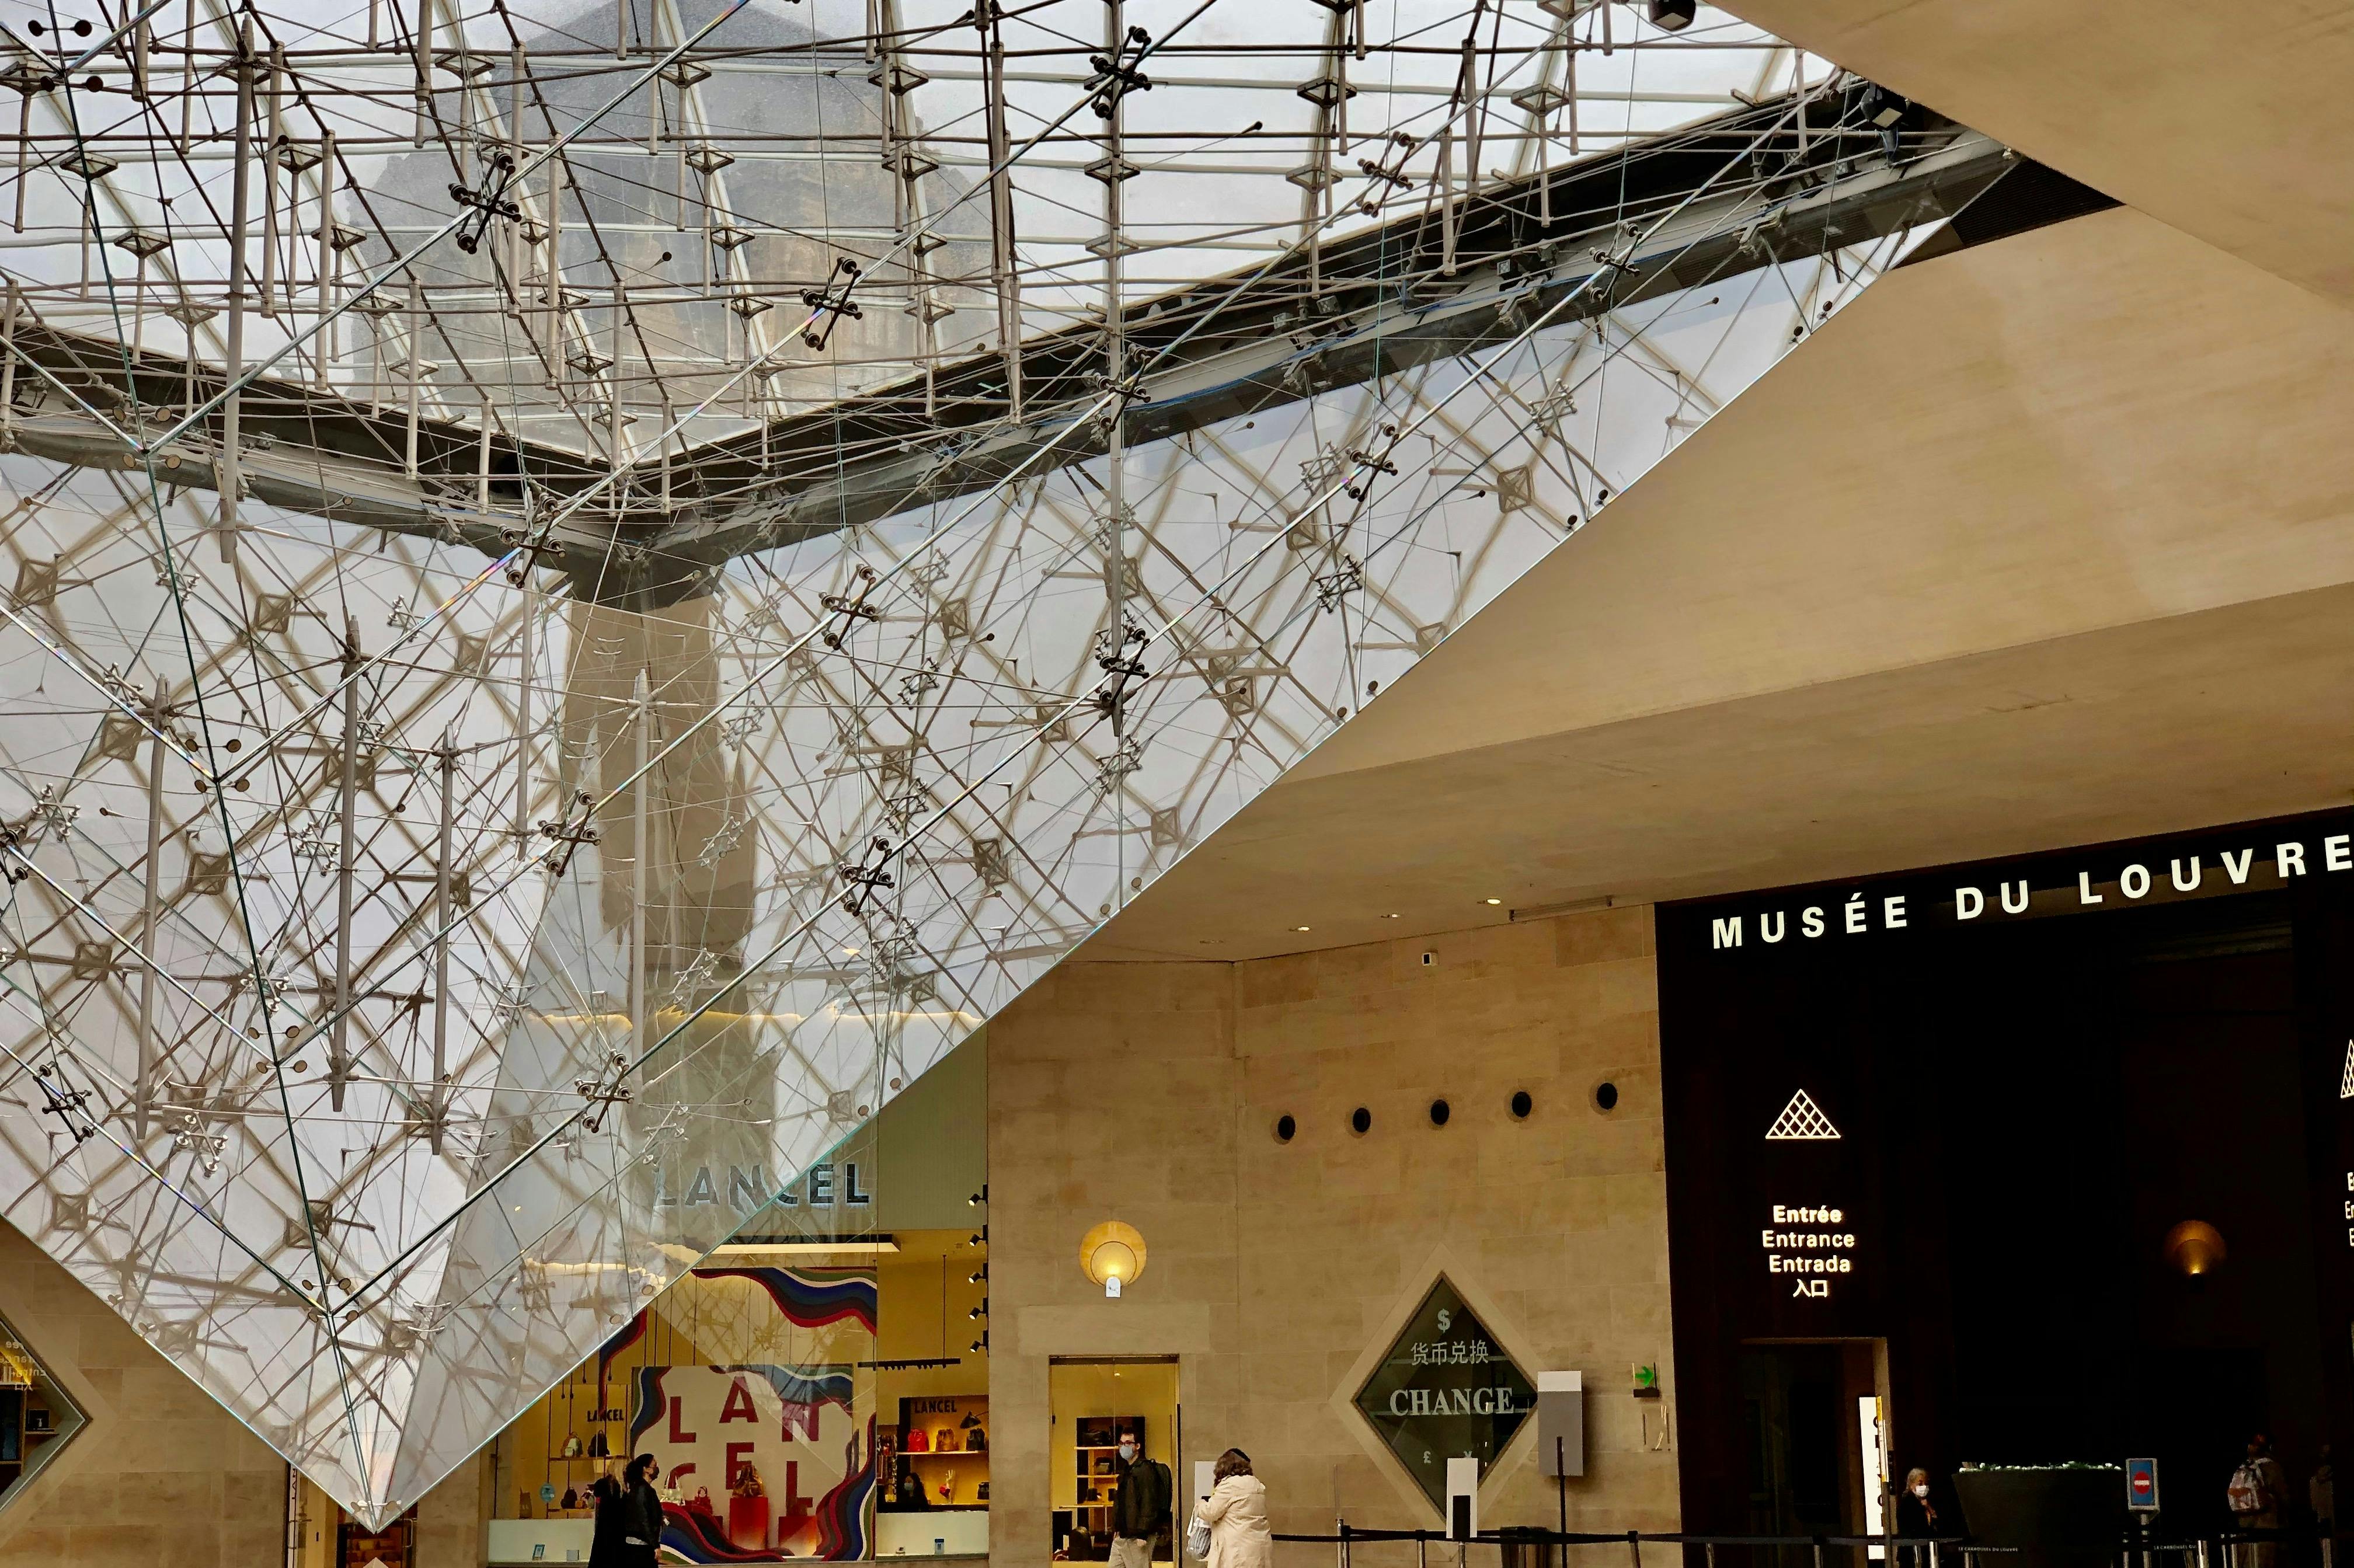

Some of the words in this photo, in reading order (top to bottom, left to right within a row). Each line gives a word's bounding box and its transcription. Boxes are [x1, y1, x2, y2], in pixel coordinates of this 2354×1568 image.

[1712, 892, 1907, 949] MUSÉE
[1956, 880, 2029, 920] DU
[2078, 834, 2353, 904] LOUVRE
[1773, 1205, 1842, 1223] Entrée
[1762, 1229, 1855, 1248] Entrance
[1769, 1255, 1851, 1273] Entrada
[1792, 1278, 1828, 1298] 入口
[1437, 1308, 1451, 1333] $
[1411, 1339, 1489, 1365] 货币兑换
[914, 1400, 957, 1413] LANCEL
[1390, 1387, 1515, 1416] CHANGE
